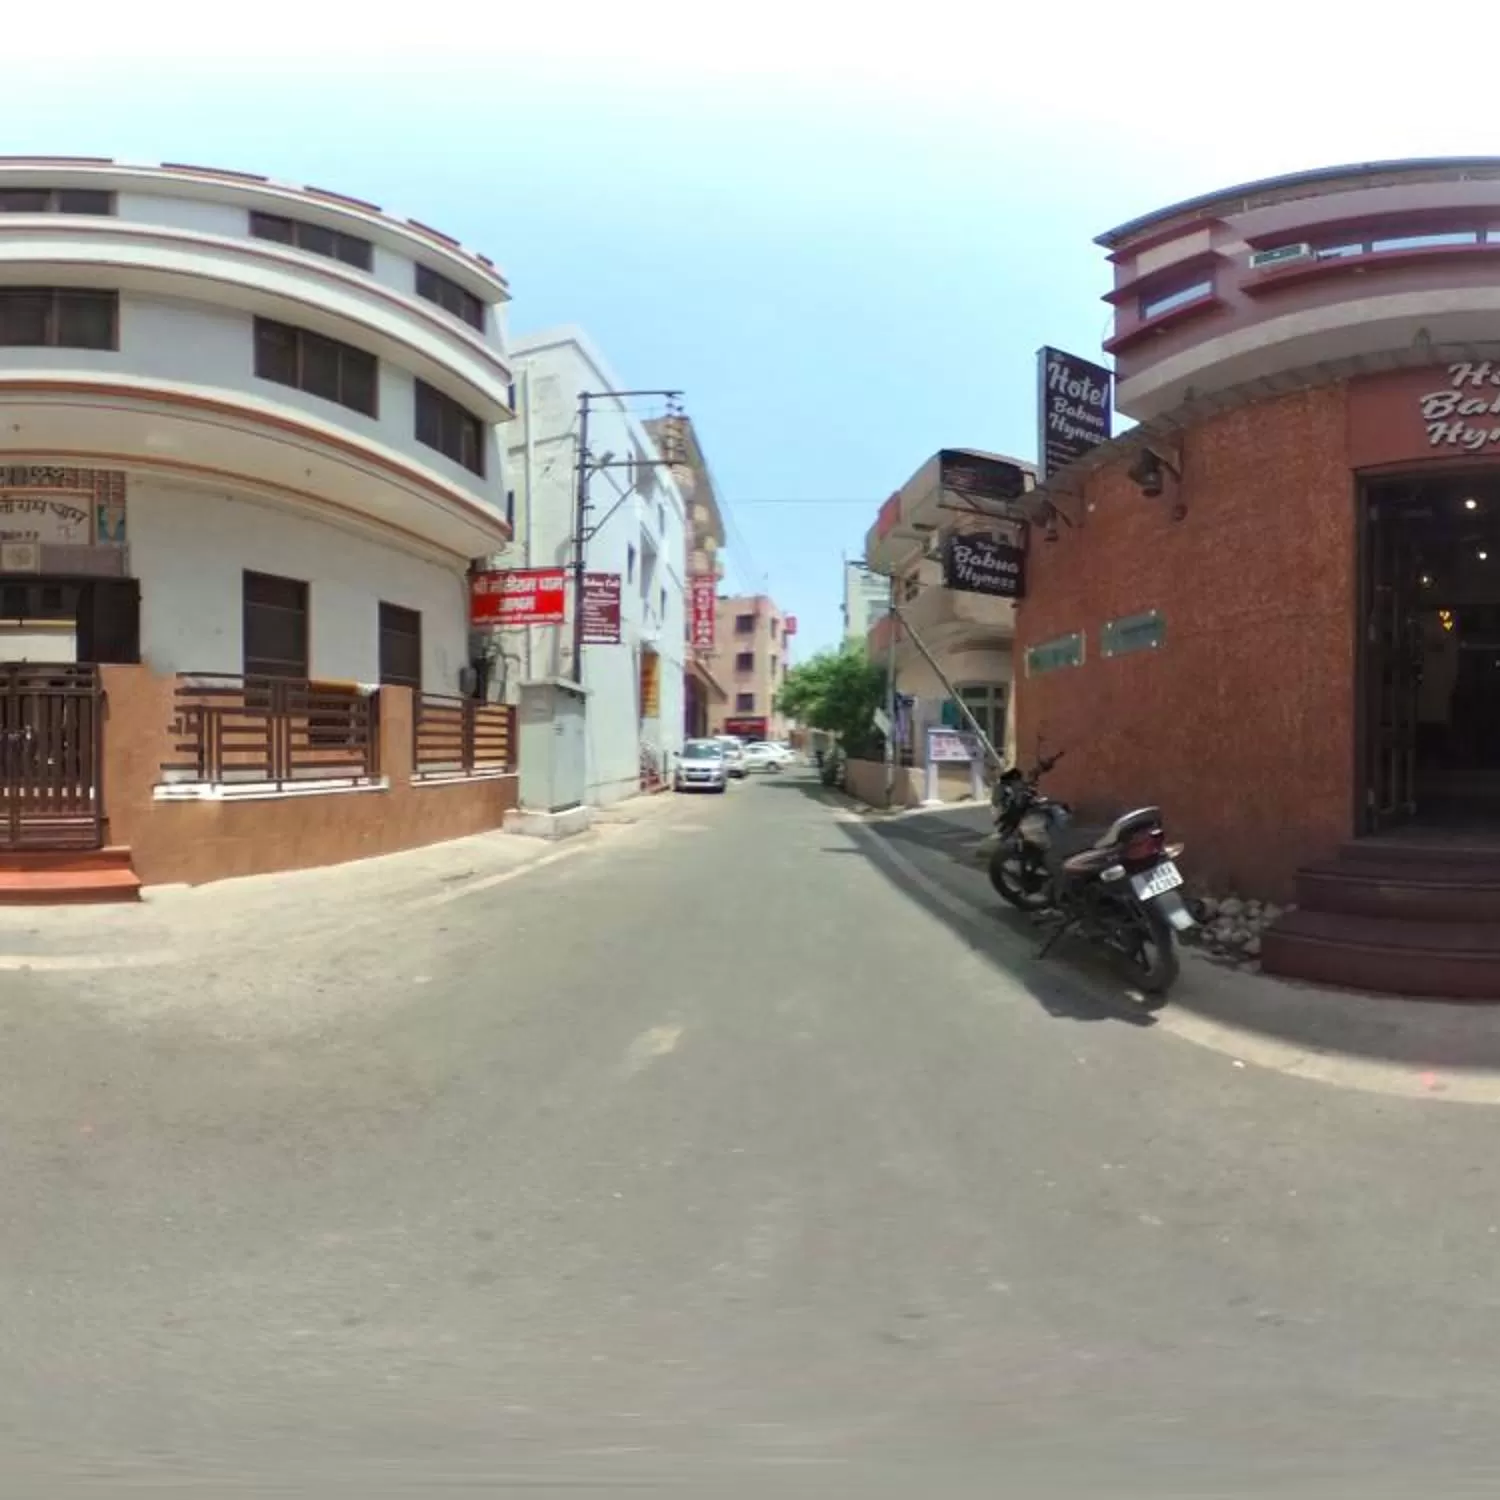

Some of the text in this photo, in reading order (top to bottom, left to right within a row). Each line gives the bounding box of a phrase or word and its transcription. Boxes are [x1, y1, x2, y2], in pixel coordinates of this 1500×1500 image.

[1048, 361, 1109, 408] Hotel
[1053, 395, 1105, 427] Babua
[953, 545, 1020, 574] Babua
